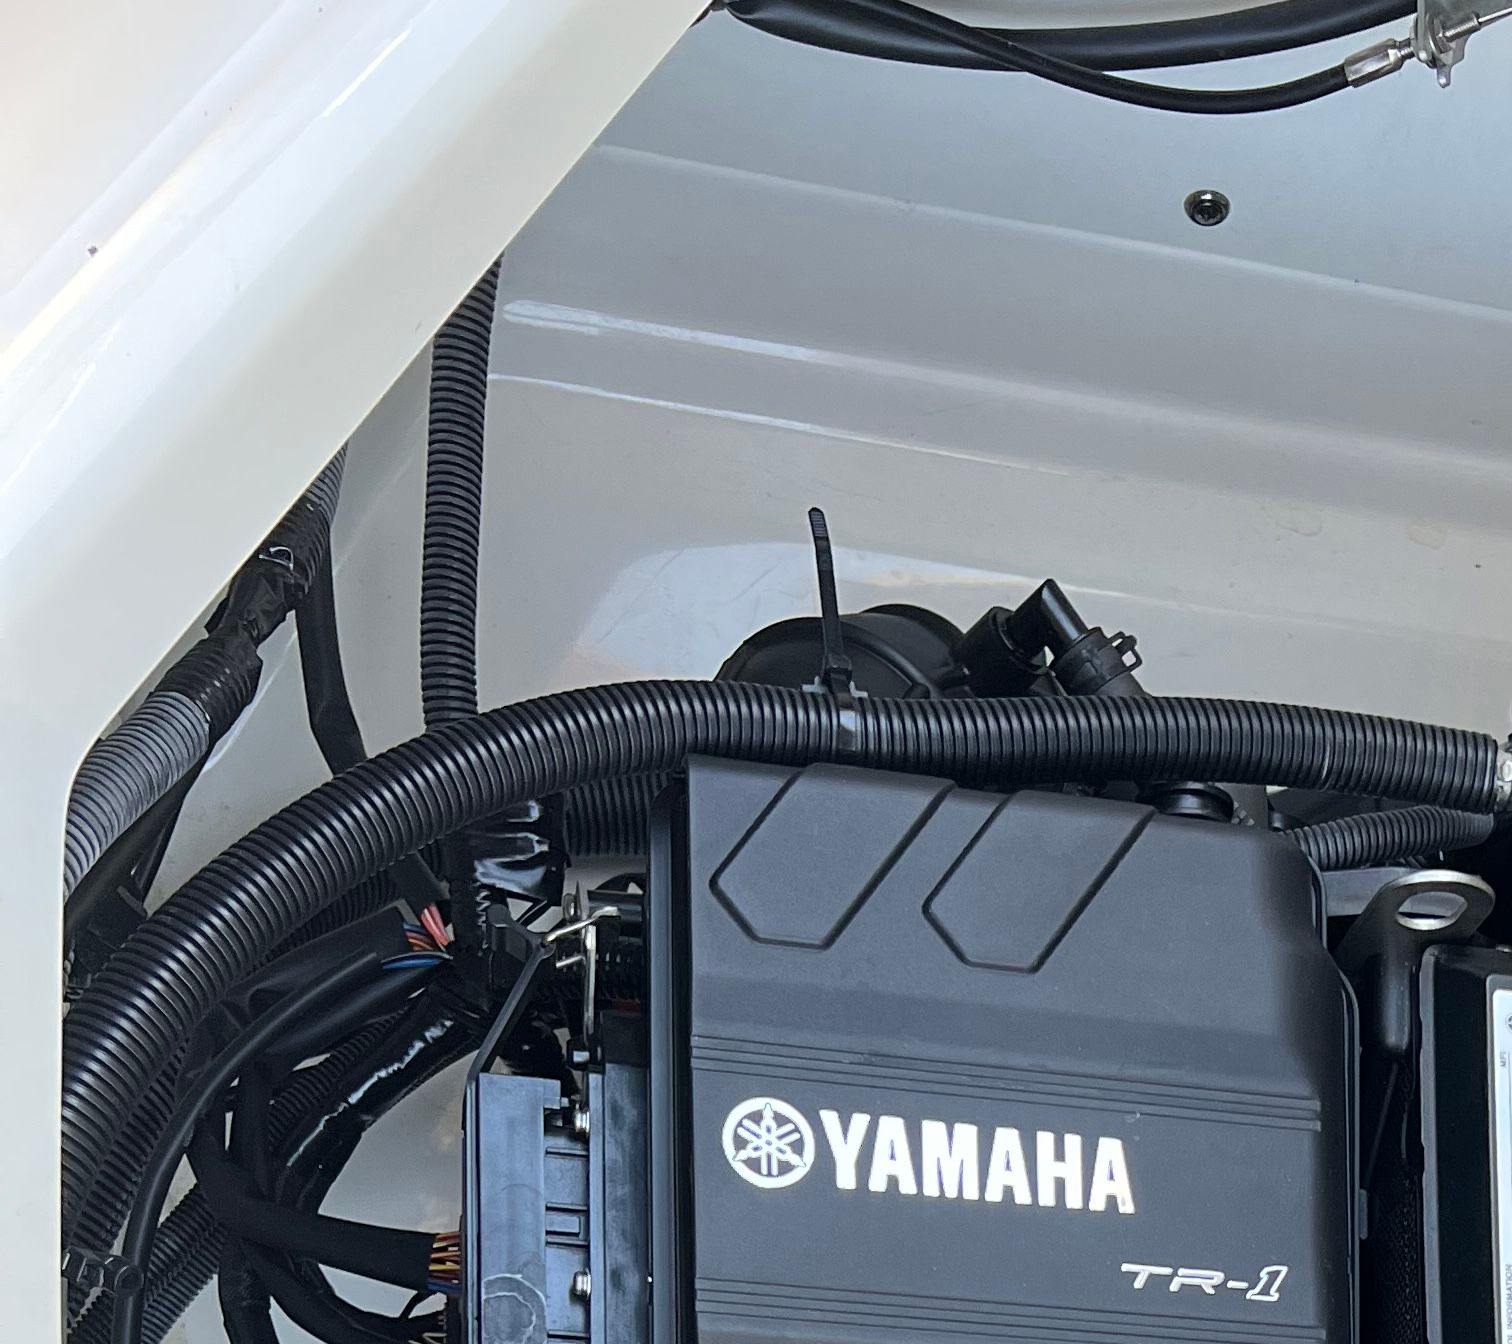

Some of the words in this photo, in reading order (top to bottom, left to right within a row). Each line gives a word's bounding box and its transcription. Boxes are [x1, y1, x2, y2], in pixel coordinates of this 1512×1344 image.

[822, 1109, 1136, 1214] YAMAHA
[1121, 1264, 1289, 1303] TR-1
[1505, 1263, 1512, 1329] INFORMATION
